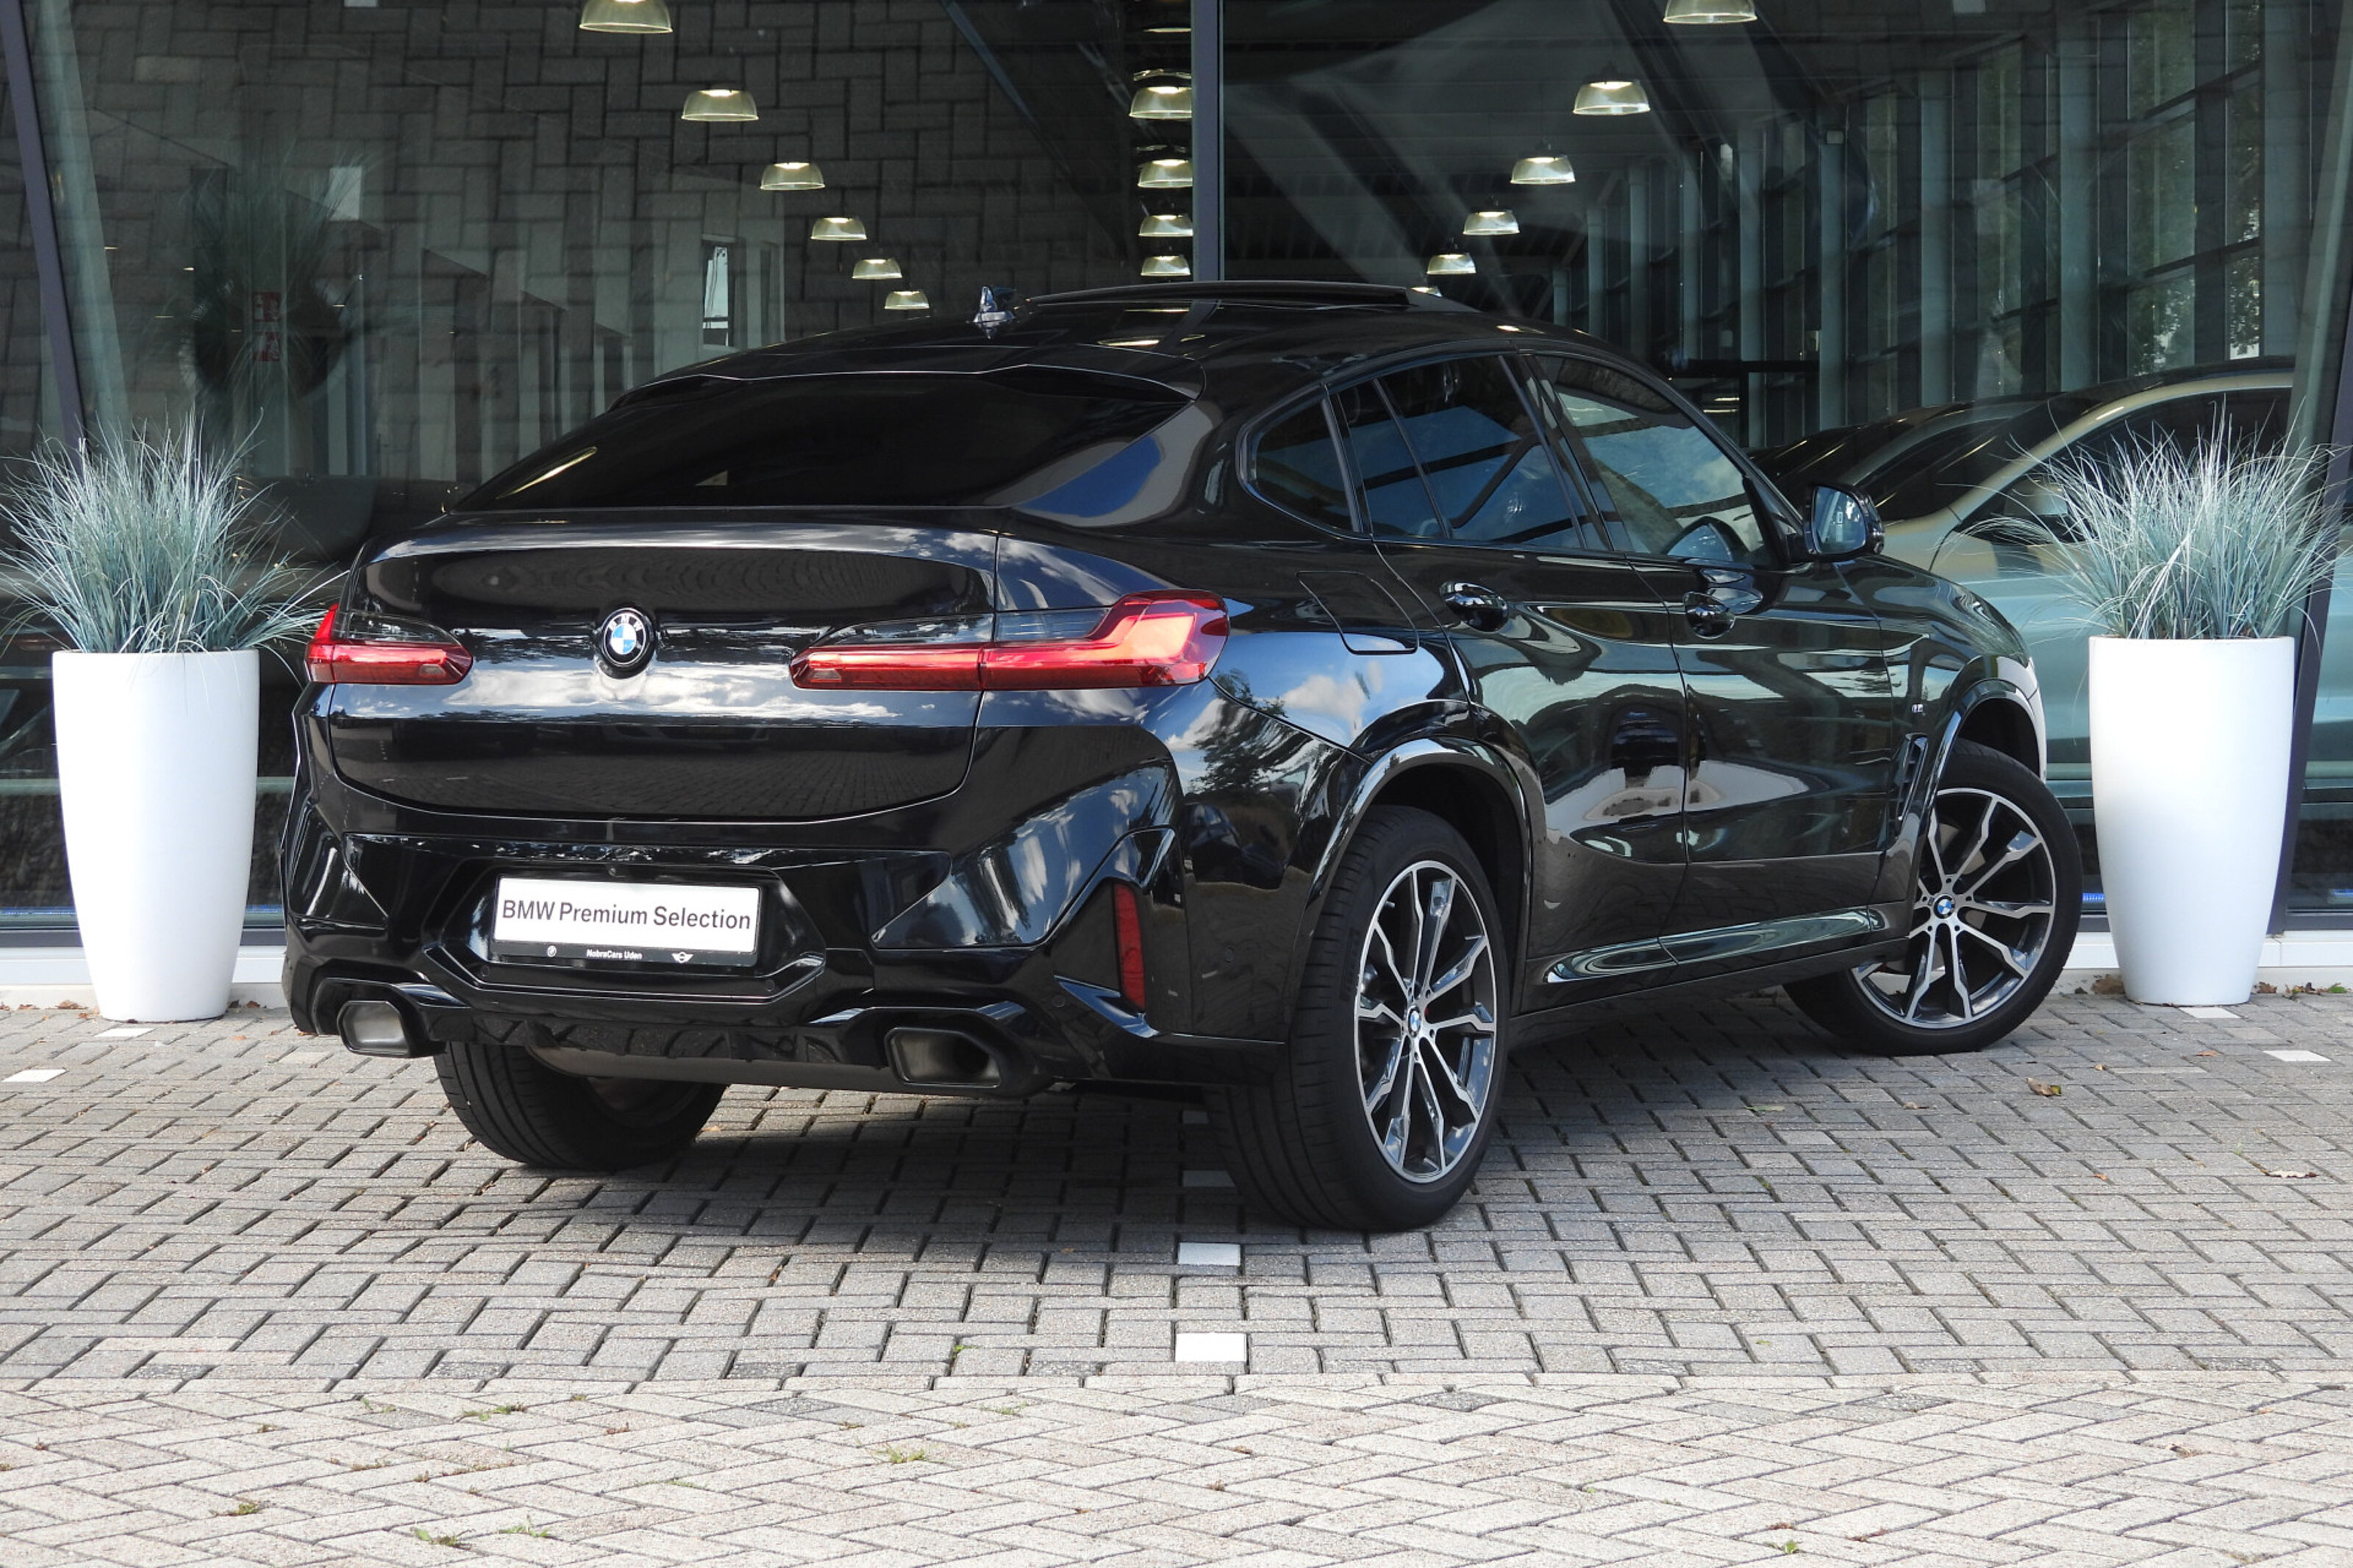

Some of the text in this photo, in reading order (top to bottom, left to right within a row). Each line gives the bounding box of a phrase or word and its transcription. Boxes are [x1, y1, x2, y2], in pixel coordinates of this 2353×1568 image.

[502, 900, 751, 930] BMW Premium Selection
[624, 950, 642, 960] Uden
